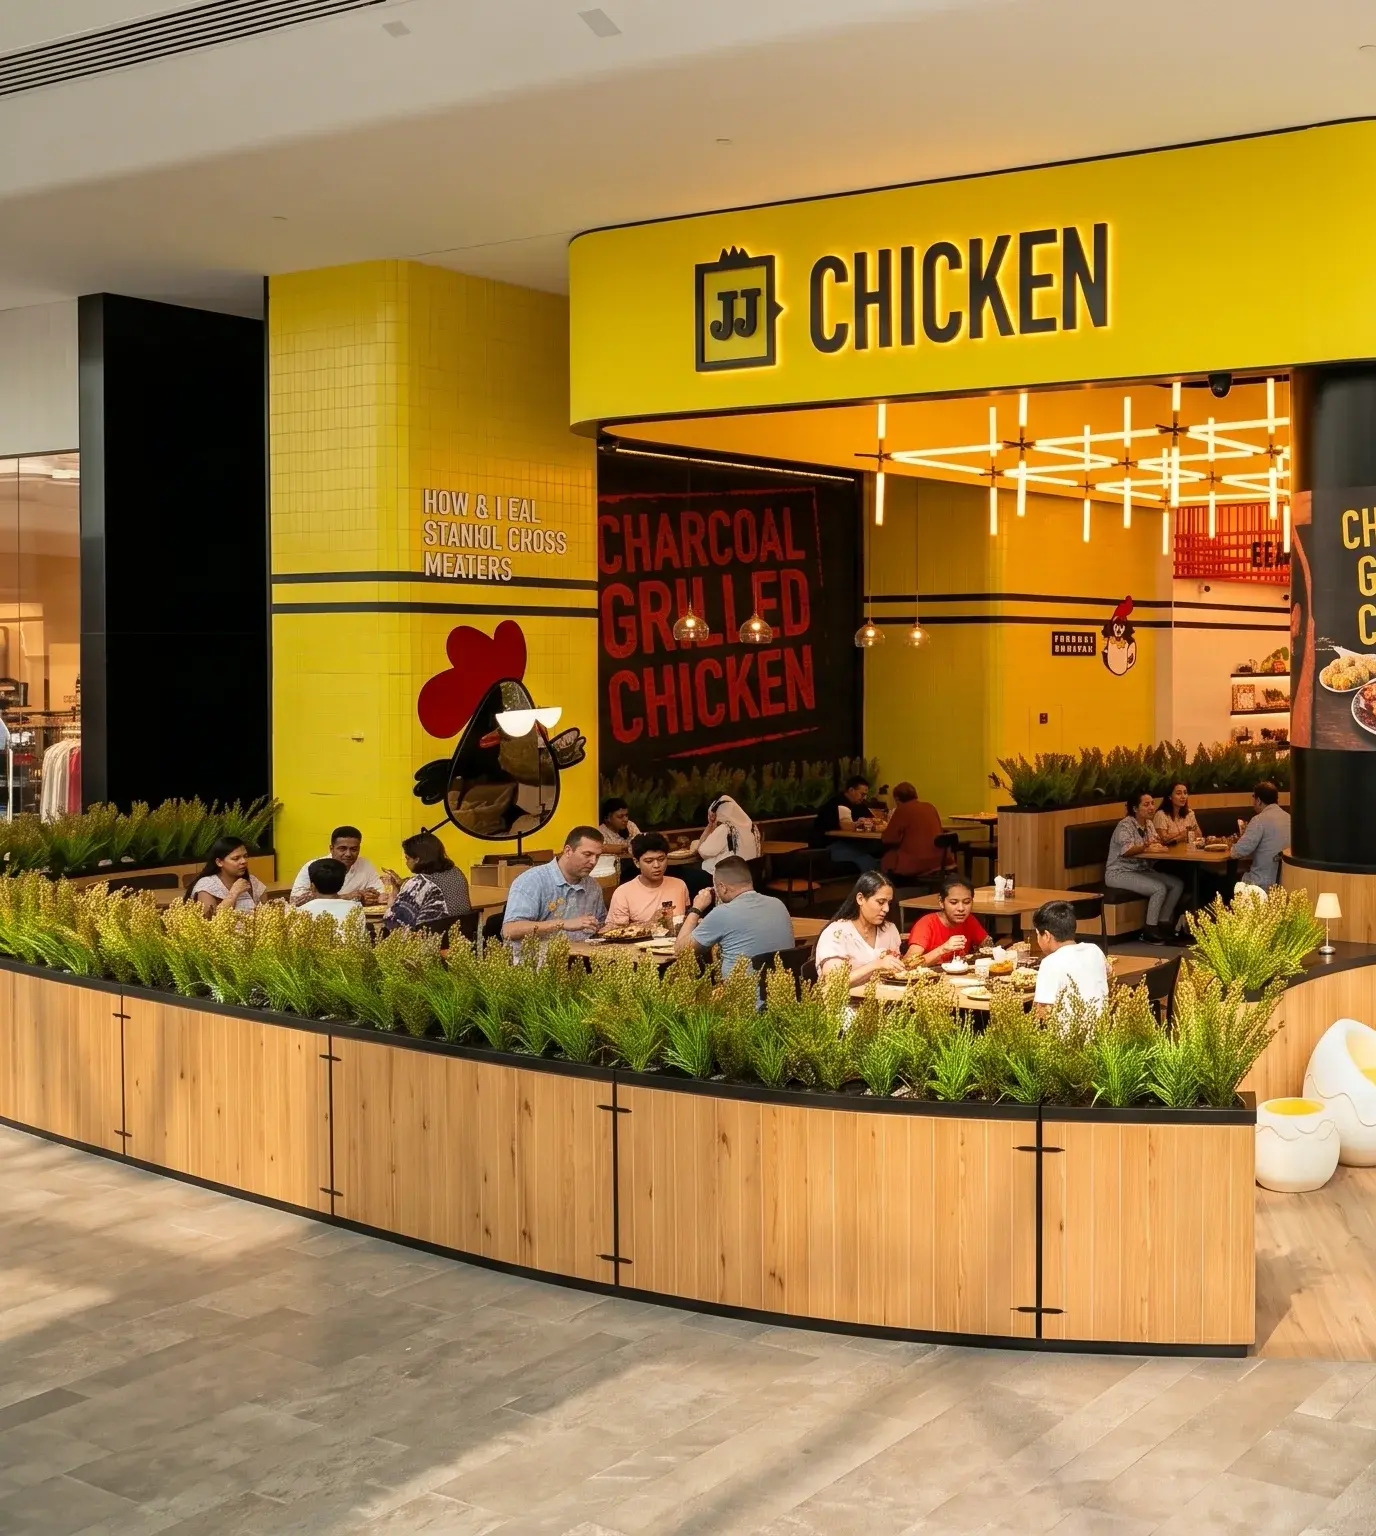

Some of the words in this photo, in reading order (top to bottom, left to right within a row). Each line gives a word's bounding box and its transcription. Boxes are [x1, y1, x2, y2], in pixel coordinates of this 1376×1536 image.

[710, 287, 761, 341] JJ
[809, 223, 1108, 354] CHICKEN
[424, 488, 469, 517] HOW
[475, 494, 489, 519] &
[508, 497, 542, 523] EAL
[424, 551, 512, 581] MEATERS
[508, 527, 567, 555] CROSS
[598, 507, 806, 574] CHARCOAL
[602, 568, 811, 659] GRILLED
[609, 644, 816, 743] CHICKEN
